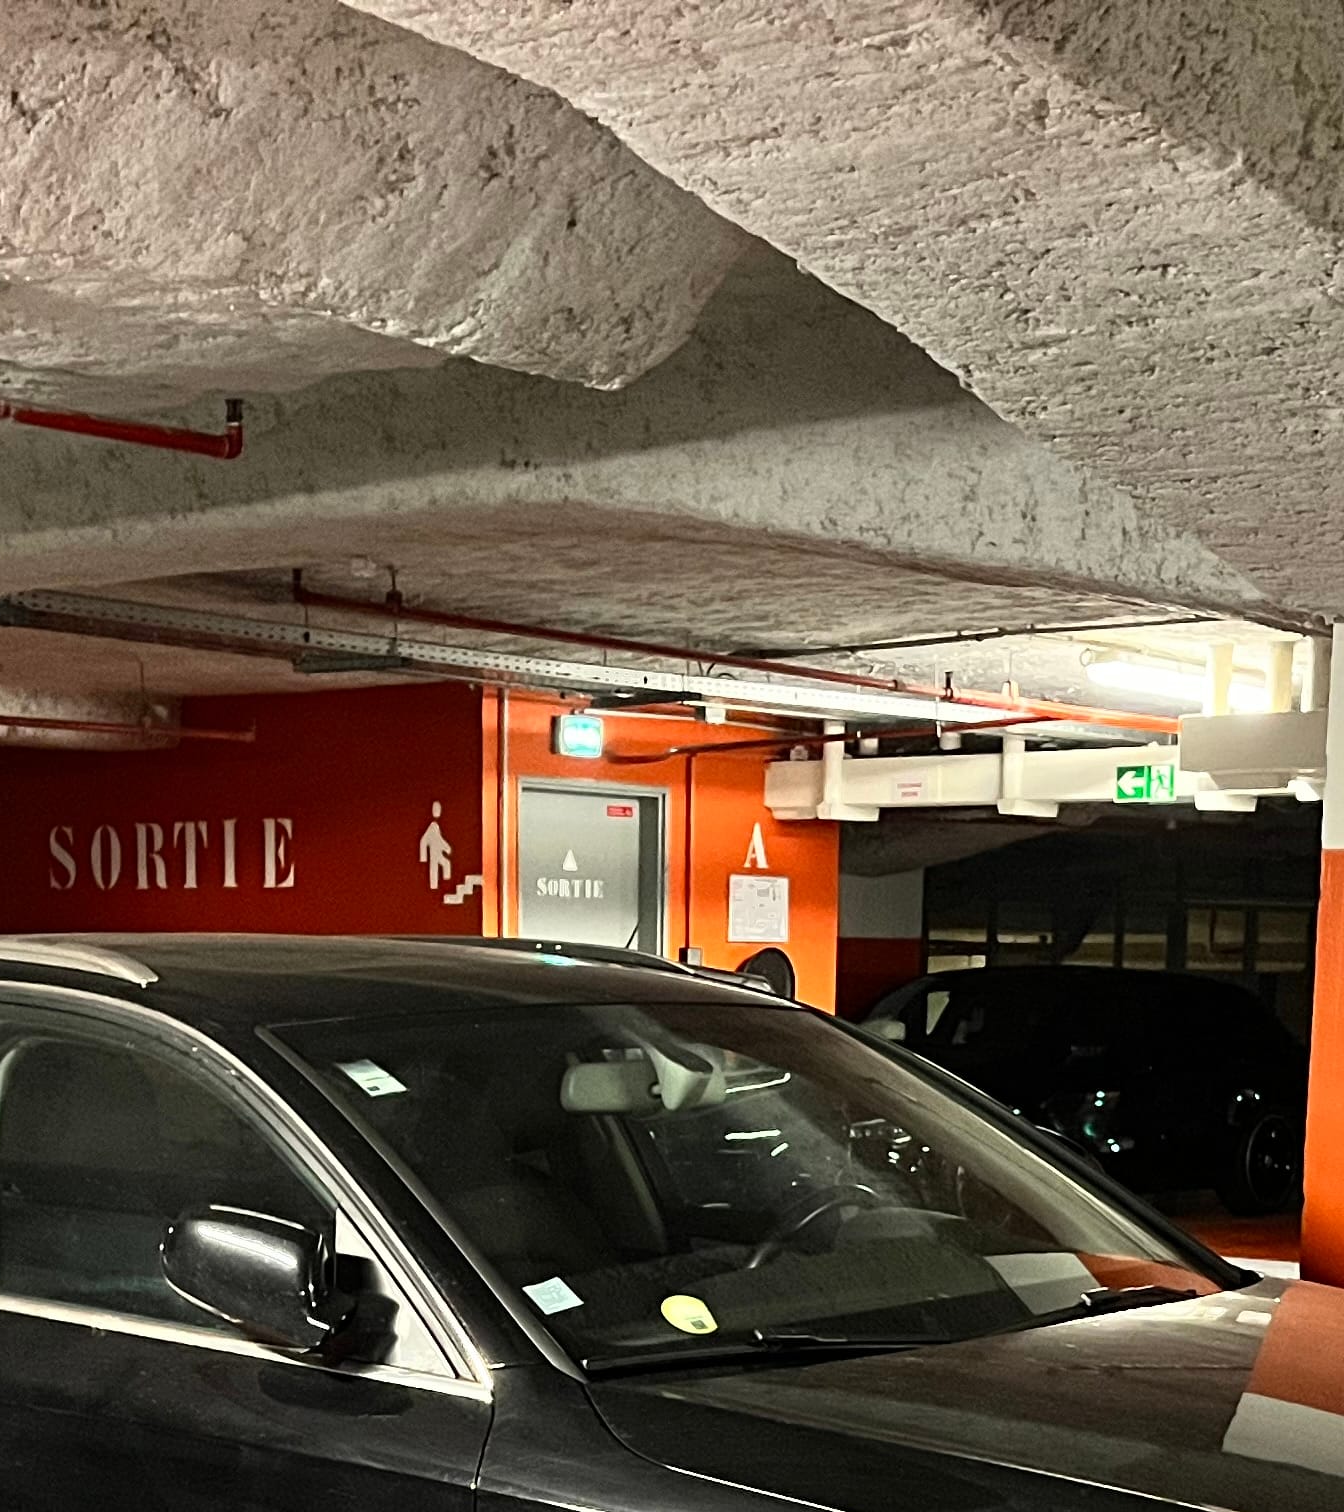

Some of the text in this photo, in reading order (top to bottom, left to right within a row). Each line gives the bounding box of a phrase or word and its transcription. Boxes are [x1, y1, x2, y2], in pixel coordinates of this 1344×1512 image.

[48, 817, 295, 890] SORTIE
[743, 821, 769, 869] A
[536, 877, 604, 899] SORTIE
